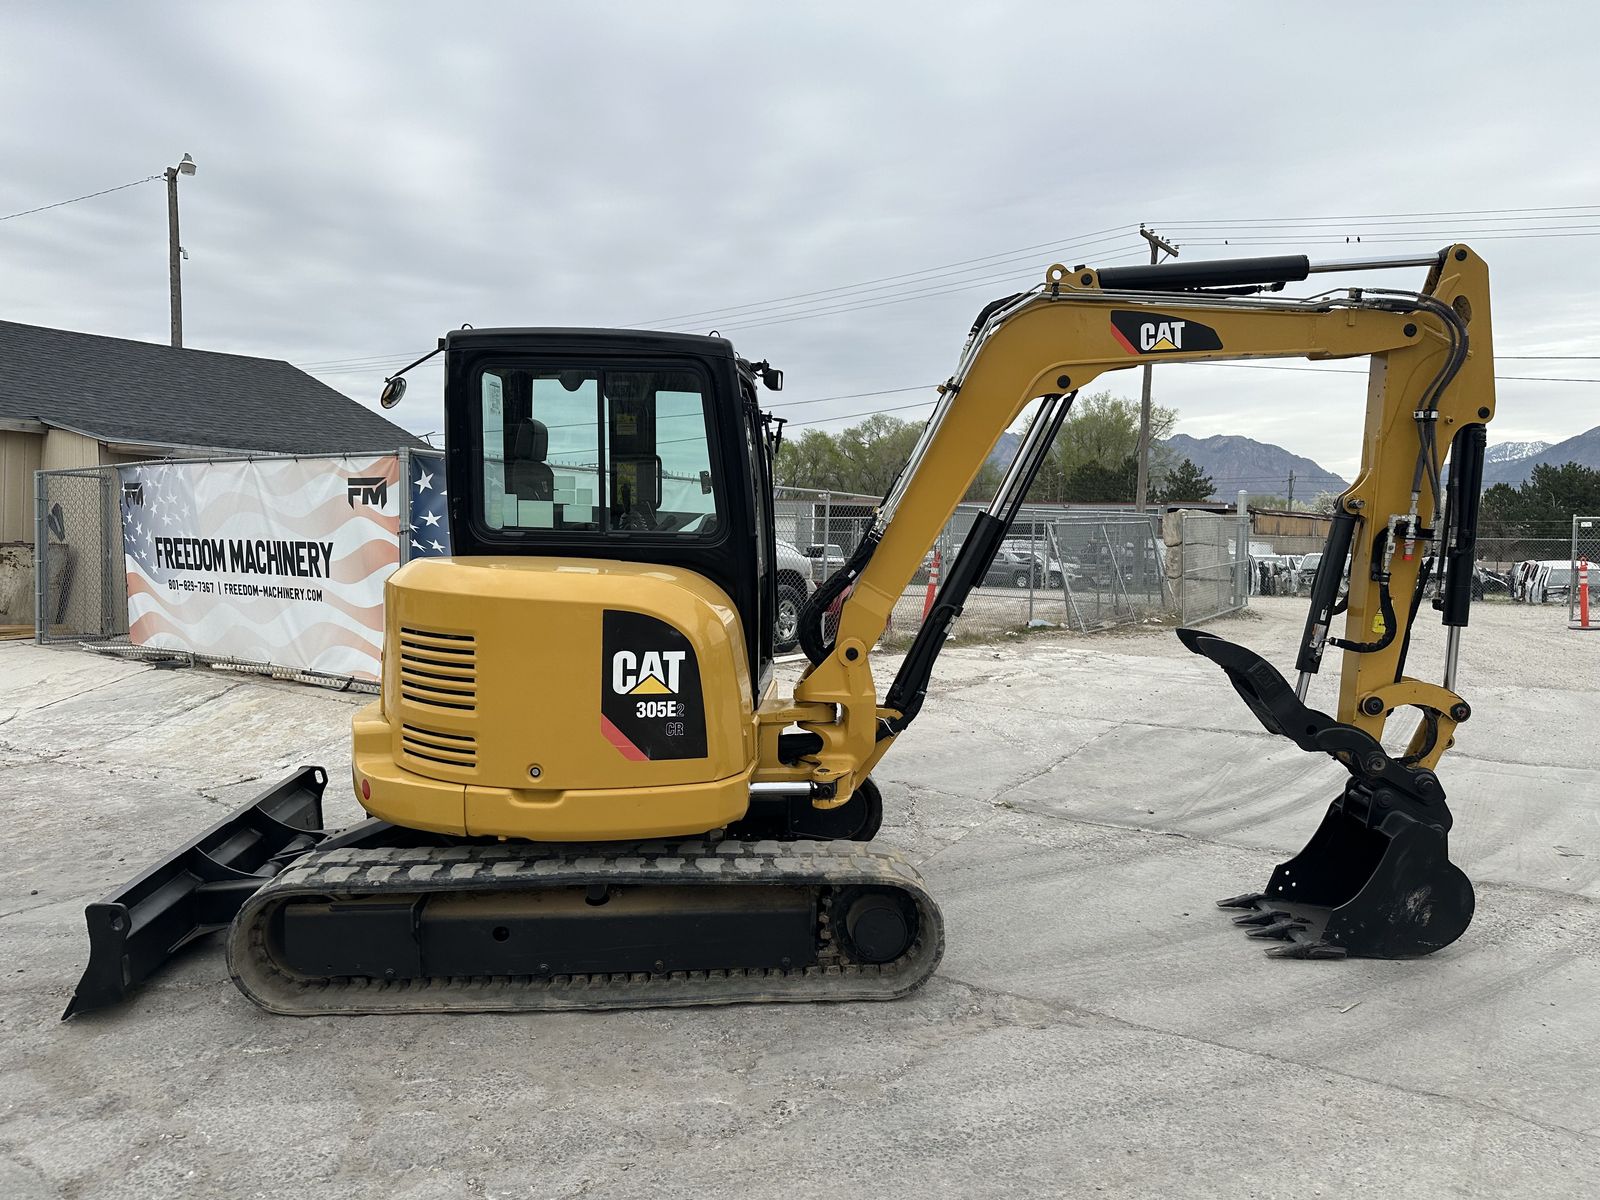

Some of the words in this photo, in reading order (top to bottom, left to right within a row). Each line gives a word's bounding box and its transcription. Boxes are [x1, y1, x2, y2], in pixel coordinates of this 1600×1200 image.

[1140, 321, 1186, 351] CAT
[155, 536, 227, 573] FREEDOM
[229, 538, 334, 579] MACHINERY
[168, 579, 214, 594] 801-829-7367
[224, 582, 323, 602] FREEDOM-MACHINERY.COM
[612, 650, 686, 695] CAT
[636, 700, 685, 718] 305E2
[665, 721, 684, 737] CR
